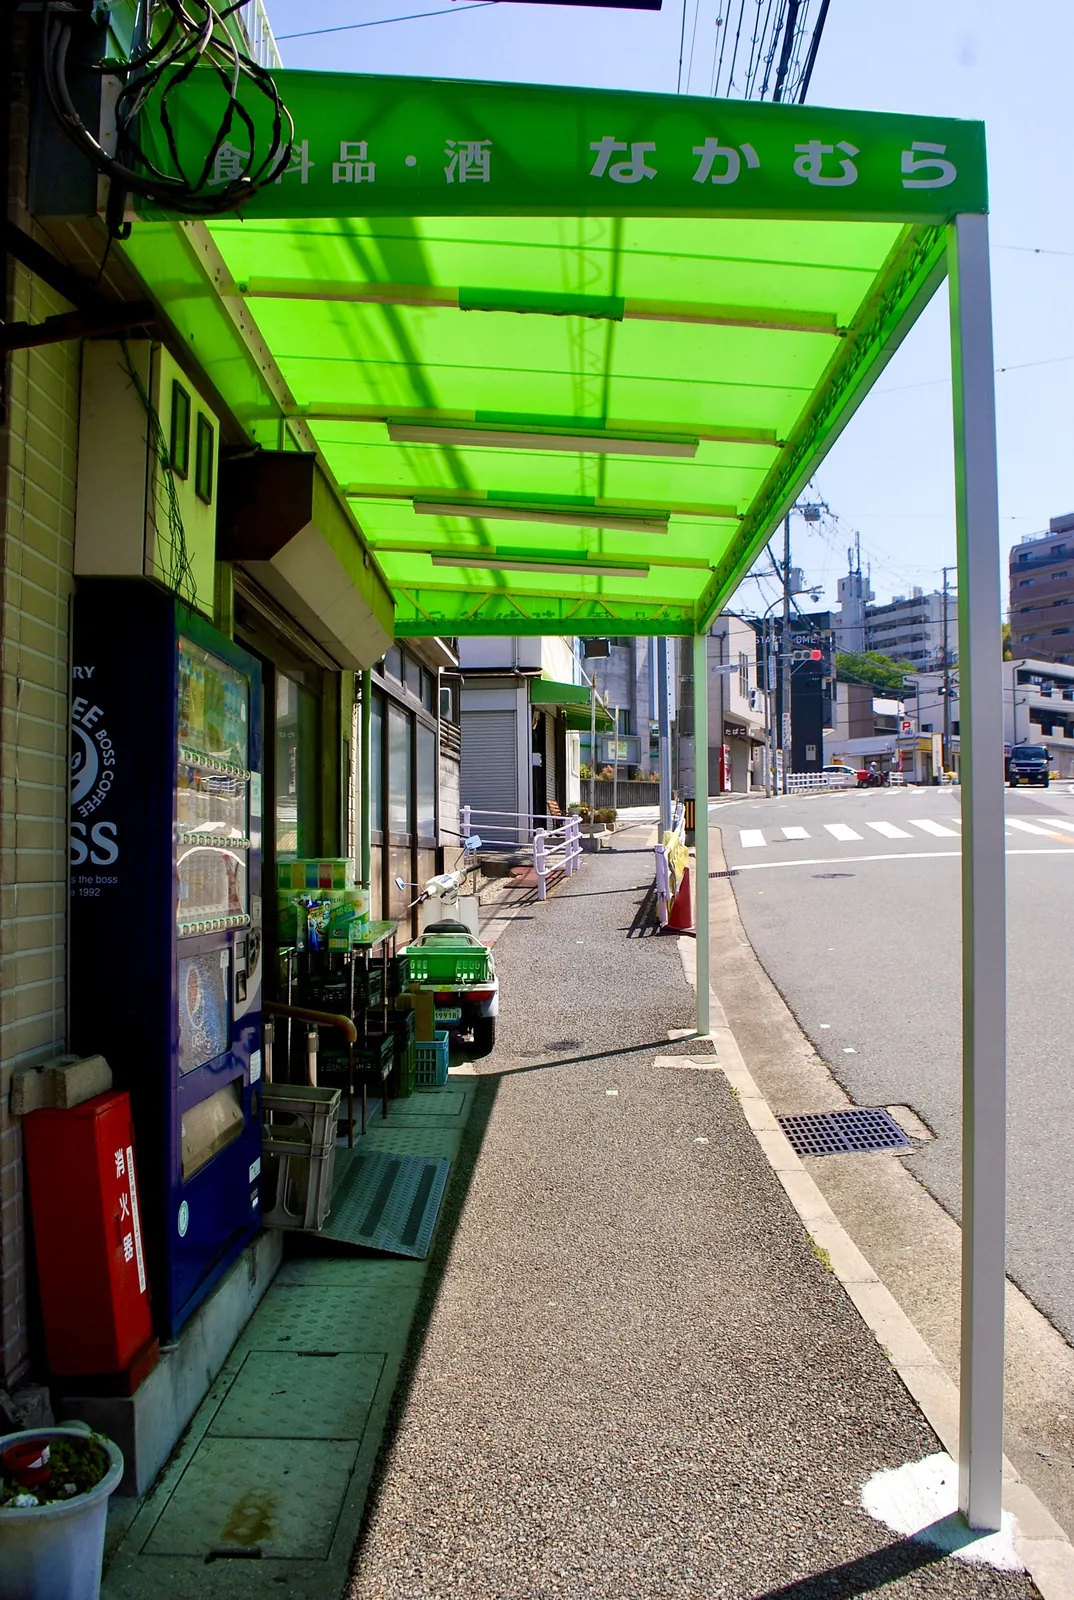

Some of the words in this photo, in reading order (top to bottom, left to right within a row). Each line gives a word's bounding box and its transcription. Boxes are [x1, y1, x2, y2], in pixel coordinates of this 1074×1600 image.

[589, 135, 958, 189] なかむら
[725, 727, 746, 736] たばこ
[95, 729, 116, 766] BOSS
[77, 770, 114, 818] COFFEE
[78, 875, 93, 884] the
[95, 875, 118, 884] boss
[78, 888, 100, 897] 1992
